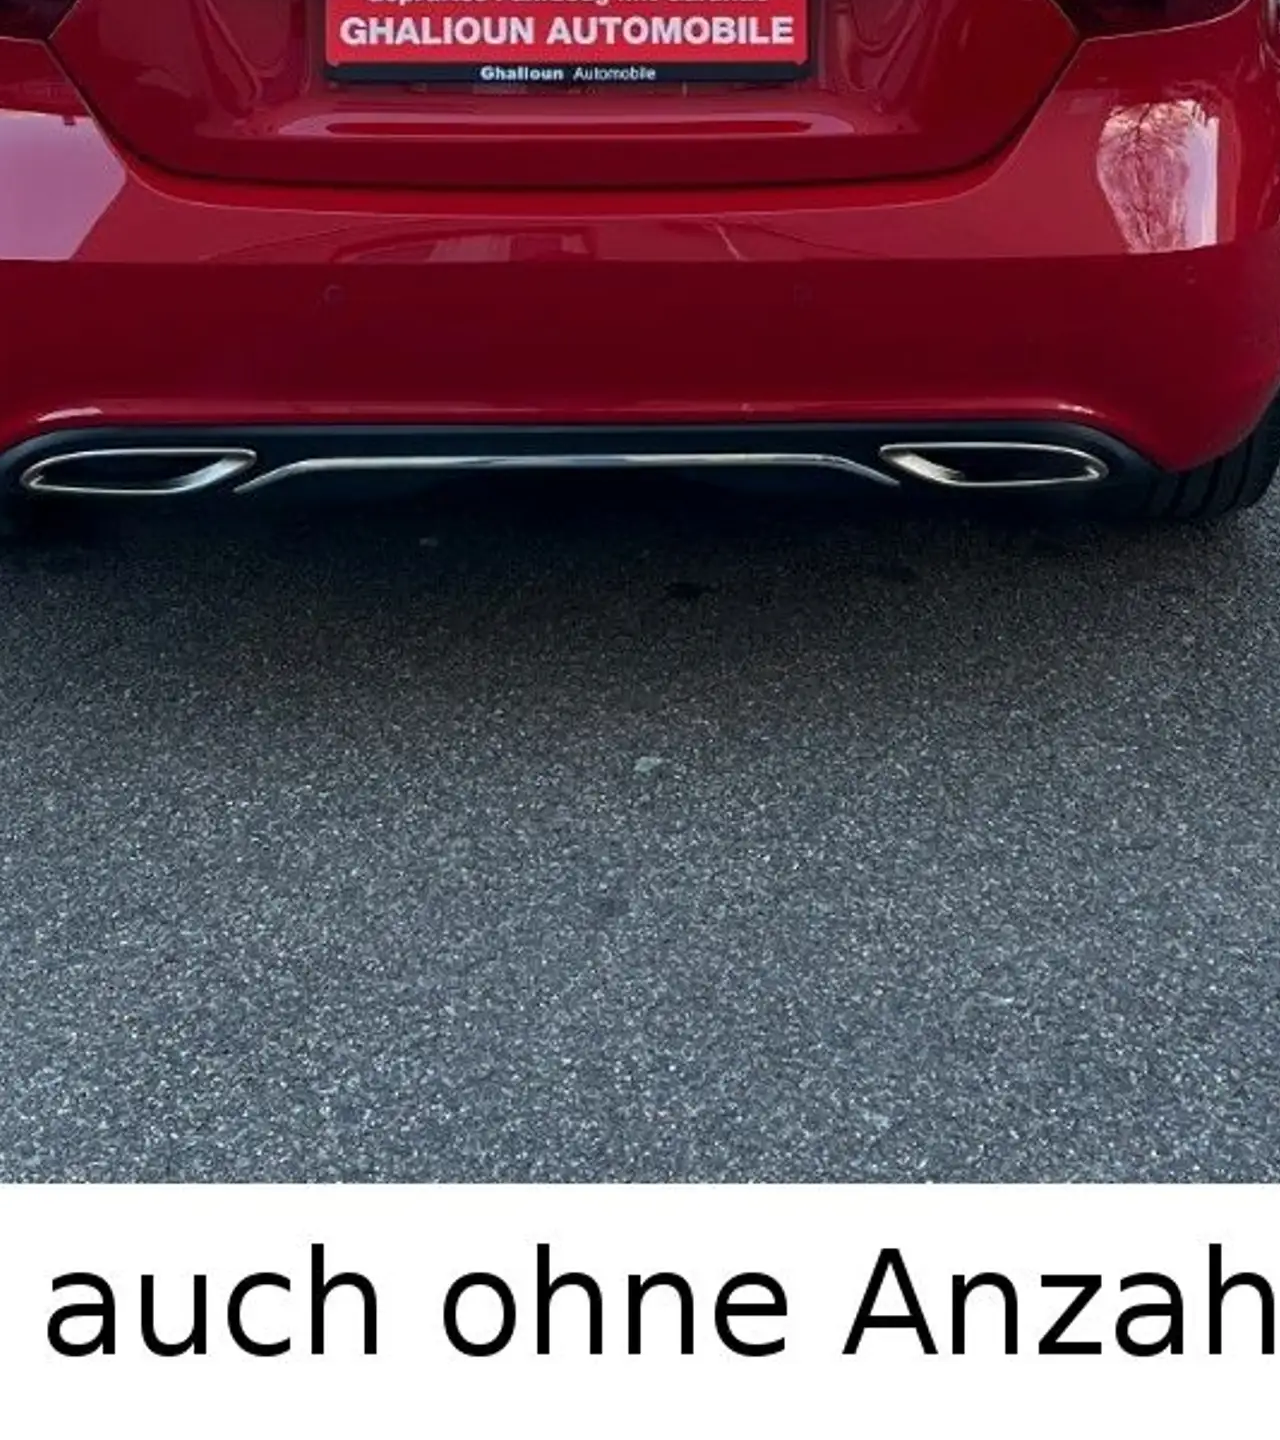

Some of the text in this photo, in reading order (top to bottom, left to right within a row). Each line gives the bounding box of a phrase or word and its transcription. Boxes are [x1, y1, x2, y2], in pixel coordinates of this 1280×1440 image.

[339, 16, 795, 46] GHALIOUN AUTOMOBILE
[480, 66, 656, 81] Ghalioun Automobile
